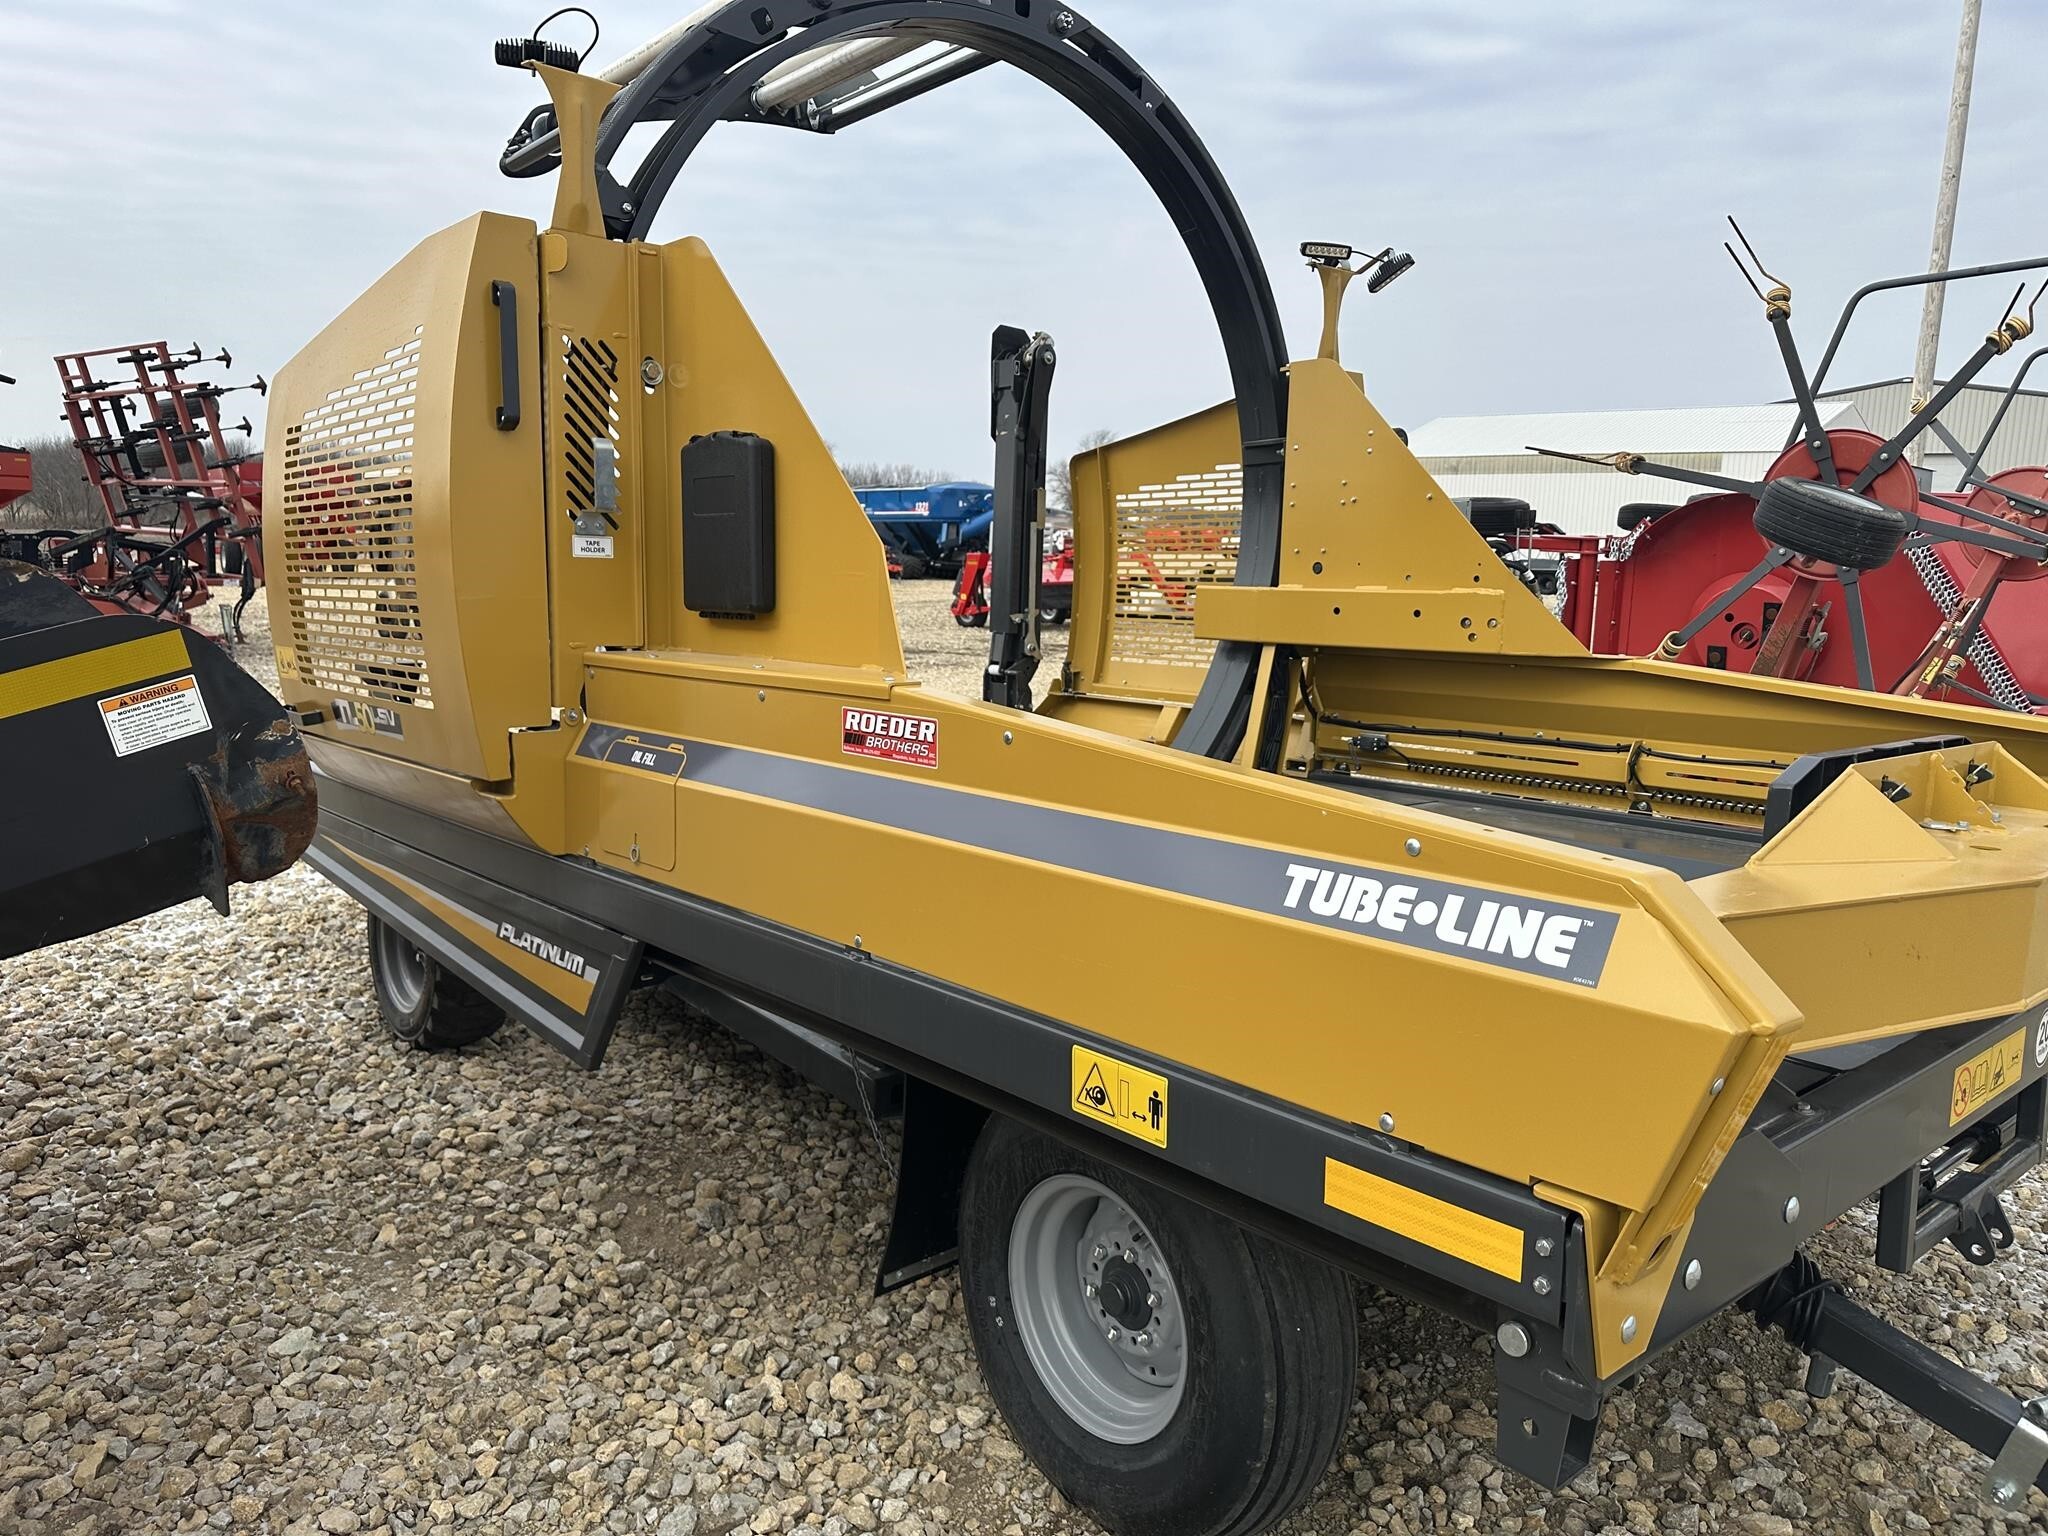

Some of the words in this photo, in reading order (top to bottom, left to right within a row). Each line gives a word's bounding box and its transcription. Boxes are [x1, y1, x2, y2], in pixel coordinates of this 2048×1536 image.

[117, 705, 141, 716] MOVING
[142, 699, 161, 709] PARTS
[161, 692, 185, 703] HAZARD
[128, 683, 179, 703] WARNING
[845, 711, 935, 743] ROEDER
[866, 736, 929, 756] BROTHERS
[631, 751, 642, 763] OIL
[641, 753, 656, 765] FILL
[499, 921, 584, 975] PLATINUM
